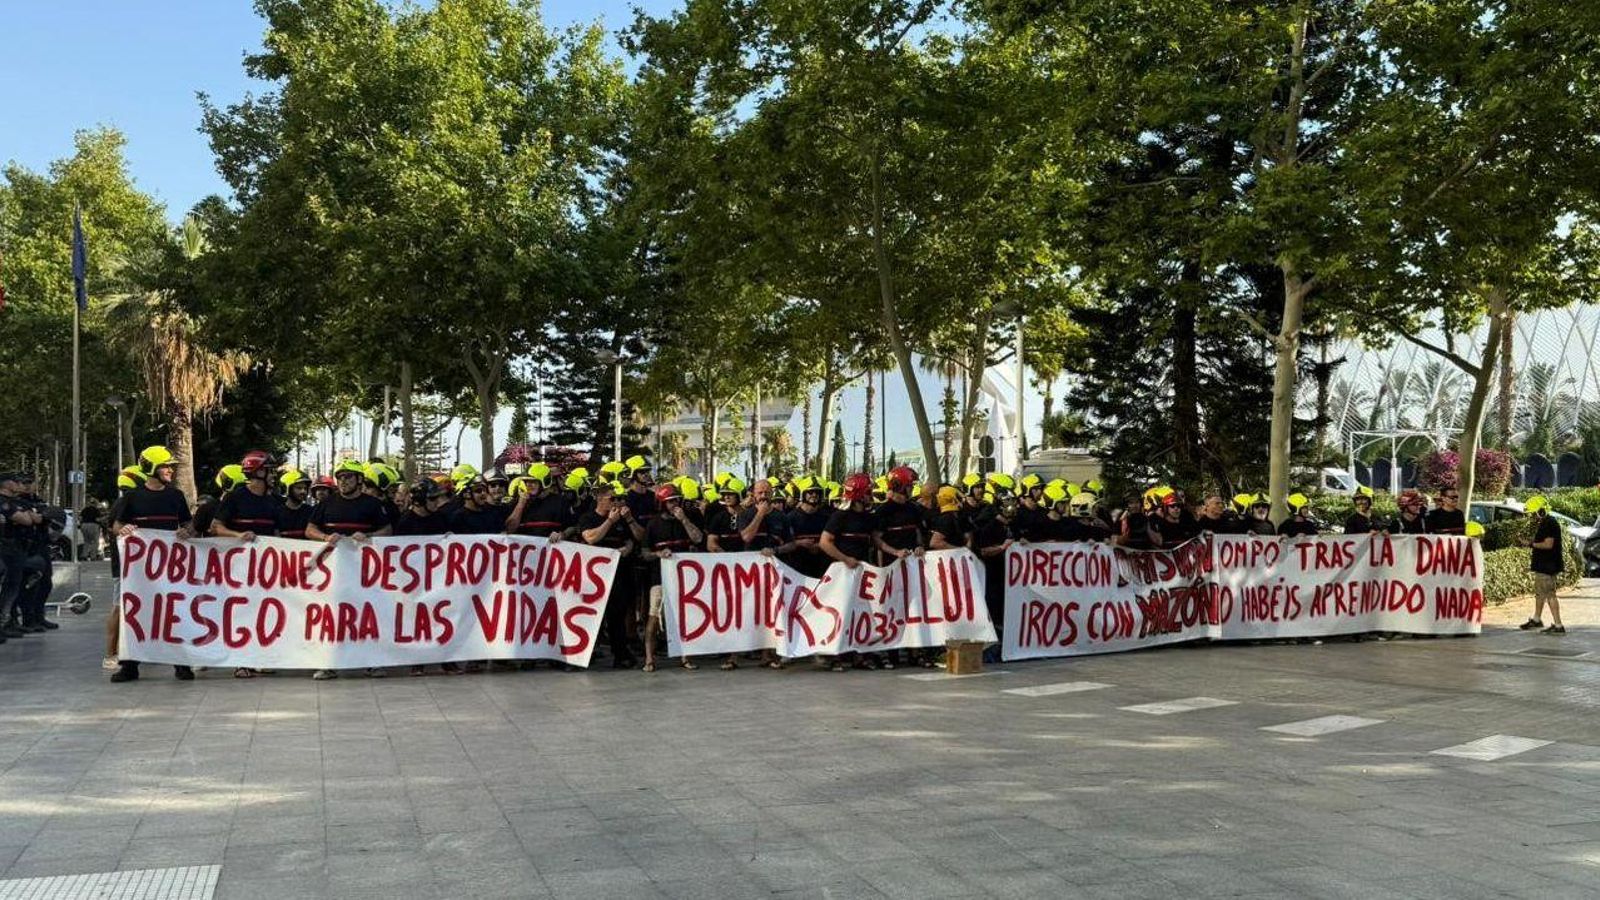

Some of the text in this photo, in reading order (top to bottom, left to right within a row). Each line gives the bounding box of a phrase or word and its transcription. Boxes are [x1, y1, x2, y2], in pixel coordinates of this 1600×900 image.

[123, 535, 612, 604] POBLACIONES DESPROTEGIDAS
[1008, 545, 1110, 589] DIRECCIÓN
[1217, 540, 1281, 568] OMPO
[1295, 541, 1356, 570] TRAS
[1370, 537, 1394, 567] LA
[1416, 536, 1478, 578] DANA
[124, 589, 600, 656] RIESGO PARA LAS VIDAS
[1019, 602, 1080, 649] IROS
[1087, 601, 1134, 642] CON
[1240, 578, 1302, 622] HABÉIS
[1309, 570, 1423, 618] APRENDIDO
[1435, 585, 1483, 622] NADA
